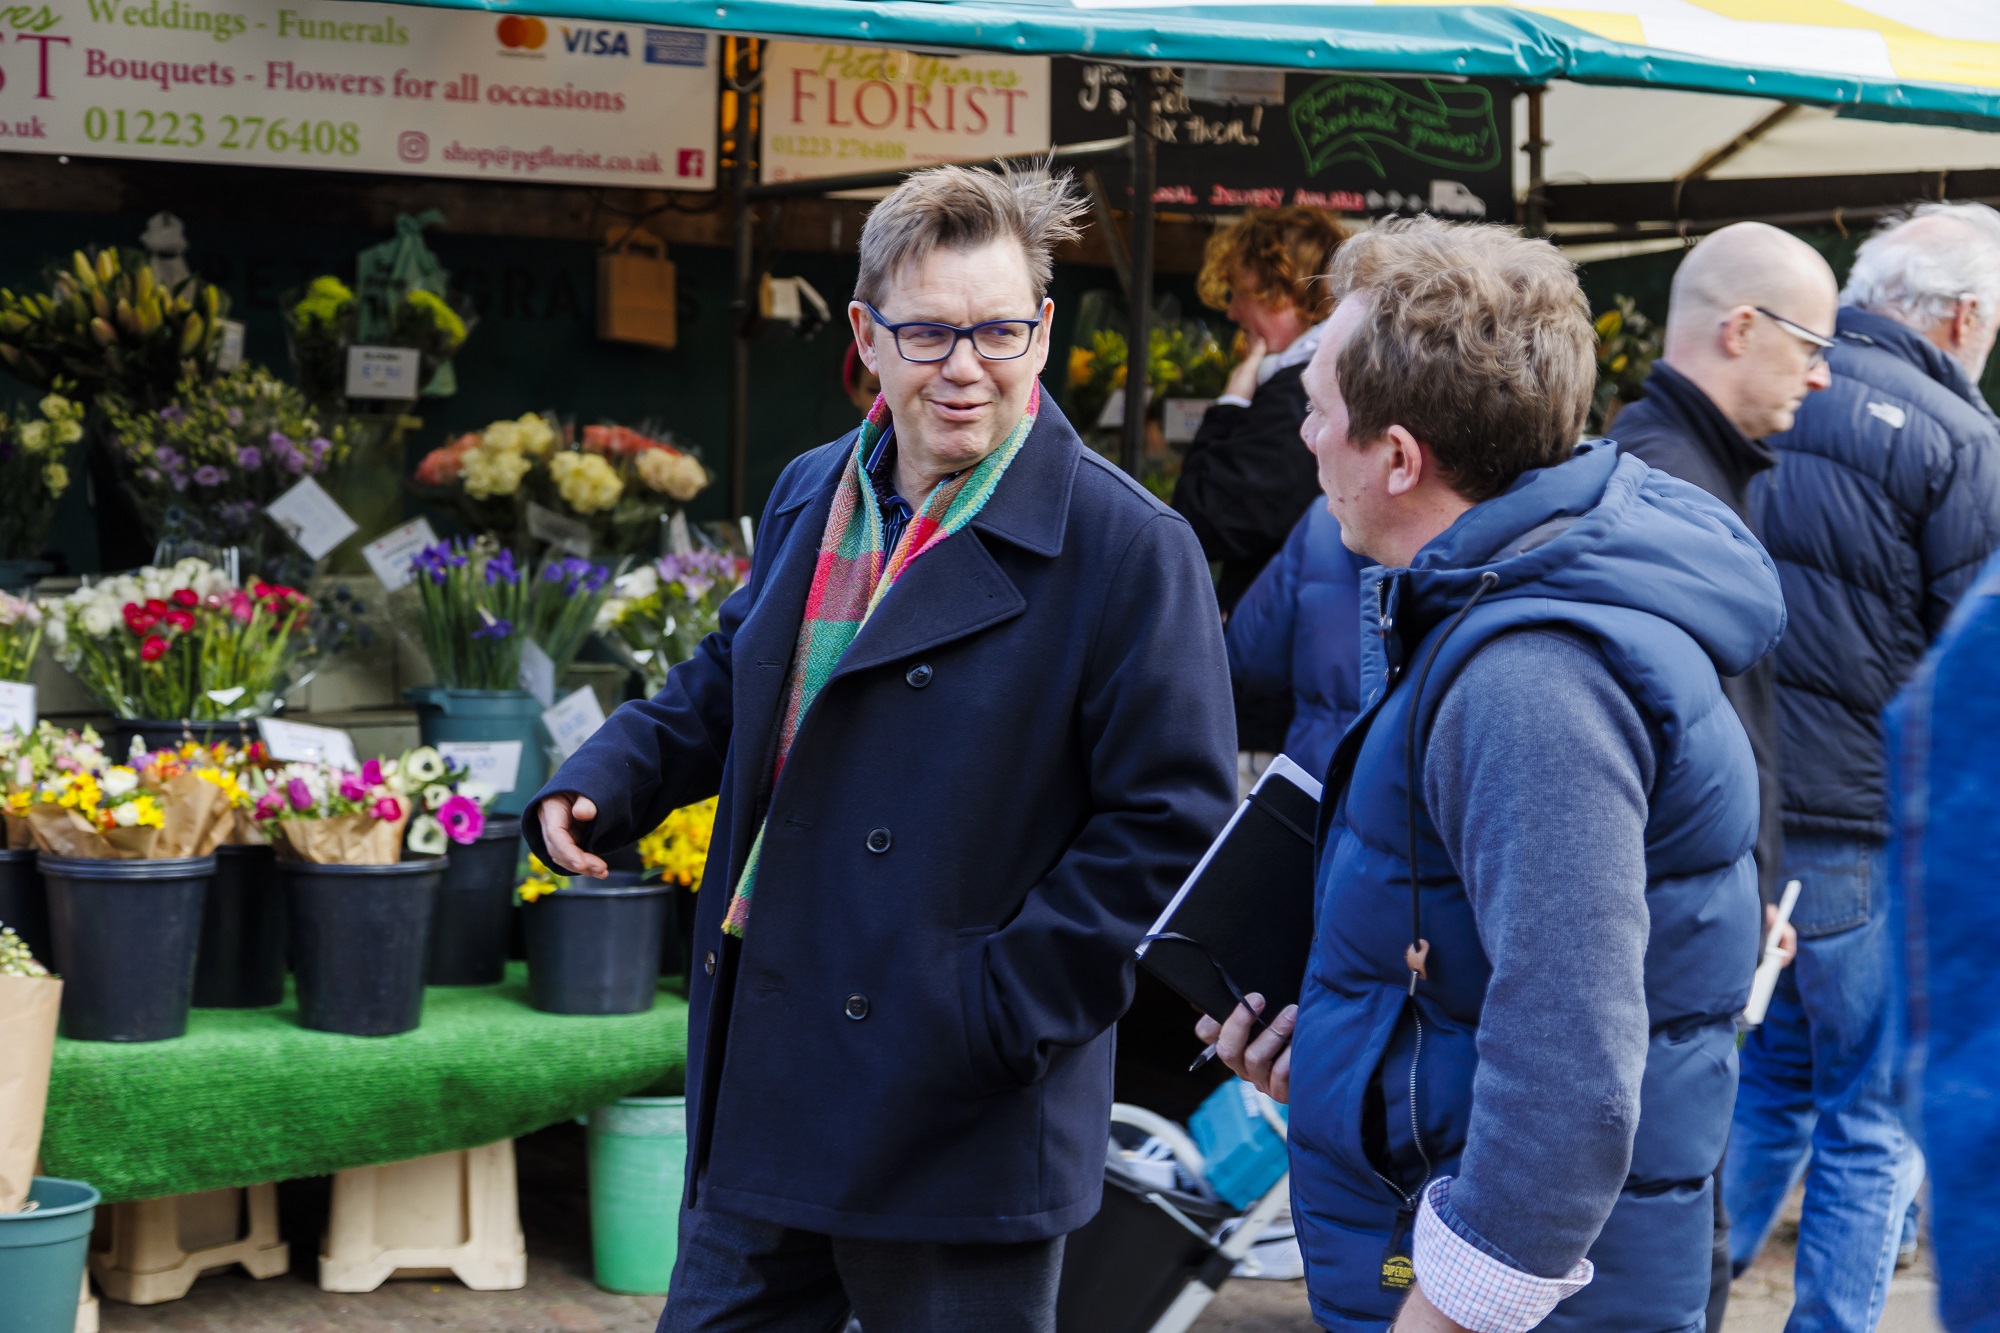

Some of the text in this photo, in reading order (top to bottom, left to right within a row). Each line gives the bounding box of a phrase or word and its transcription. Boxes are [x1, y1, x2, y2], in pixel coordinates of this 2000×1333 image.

[88, 0, 247, 42] Weddings
[277, 8, 409, 46] Funerals
[560, 26, 630, 57] VISA
[85, 48, 236, 92] Bouquets
[265, 60, 384, 97] Flowers
[393, 69, 438, 99] for
[444, 72, 481, 103] all
[486, 82, 626, 112] occasions
[791, 67, 1028, 136] FLORIST
[84, 105, 361, 157] 01223 276408
[442, 139, 664, 175] shop@pgflorist.co.uk
